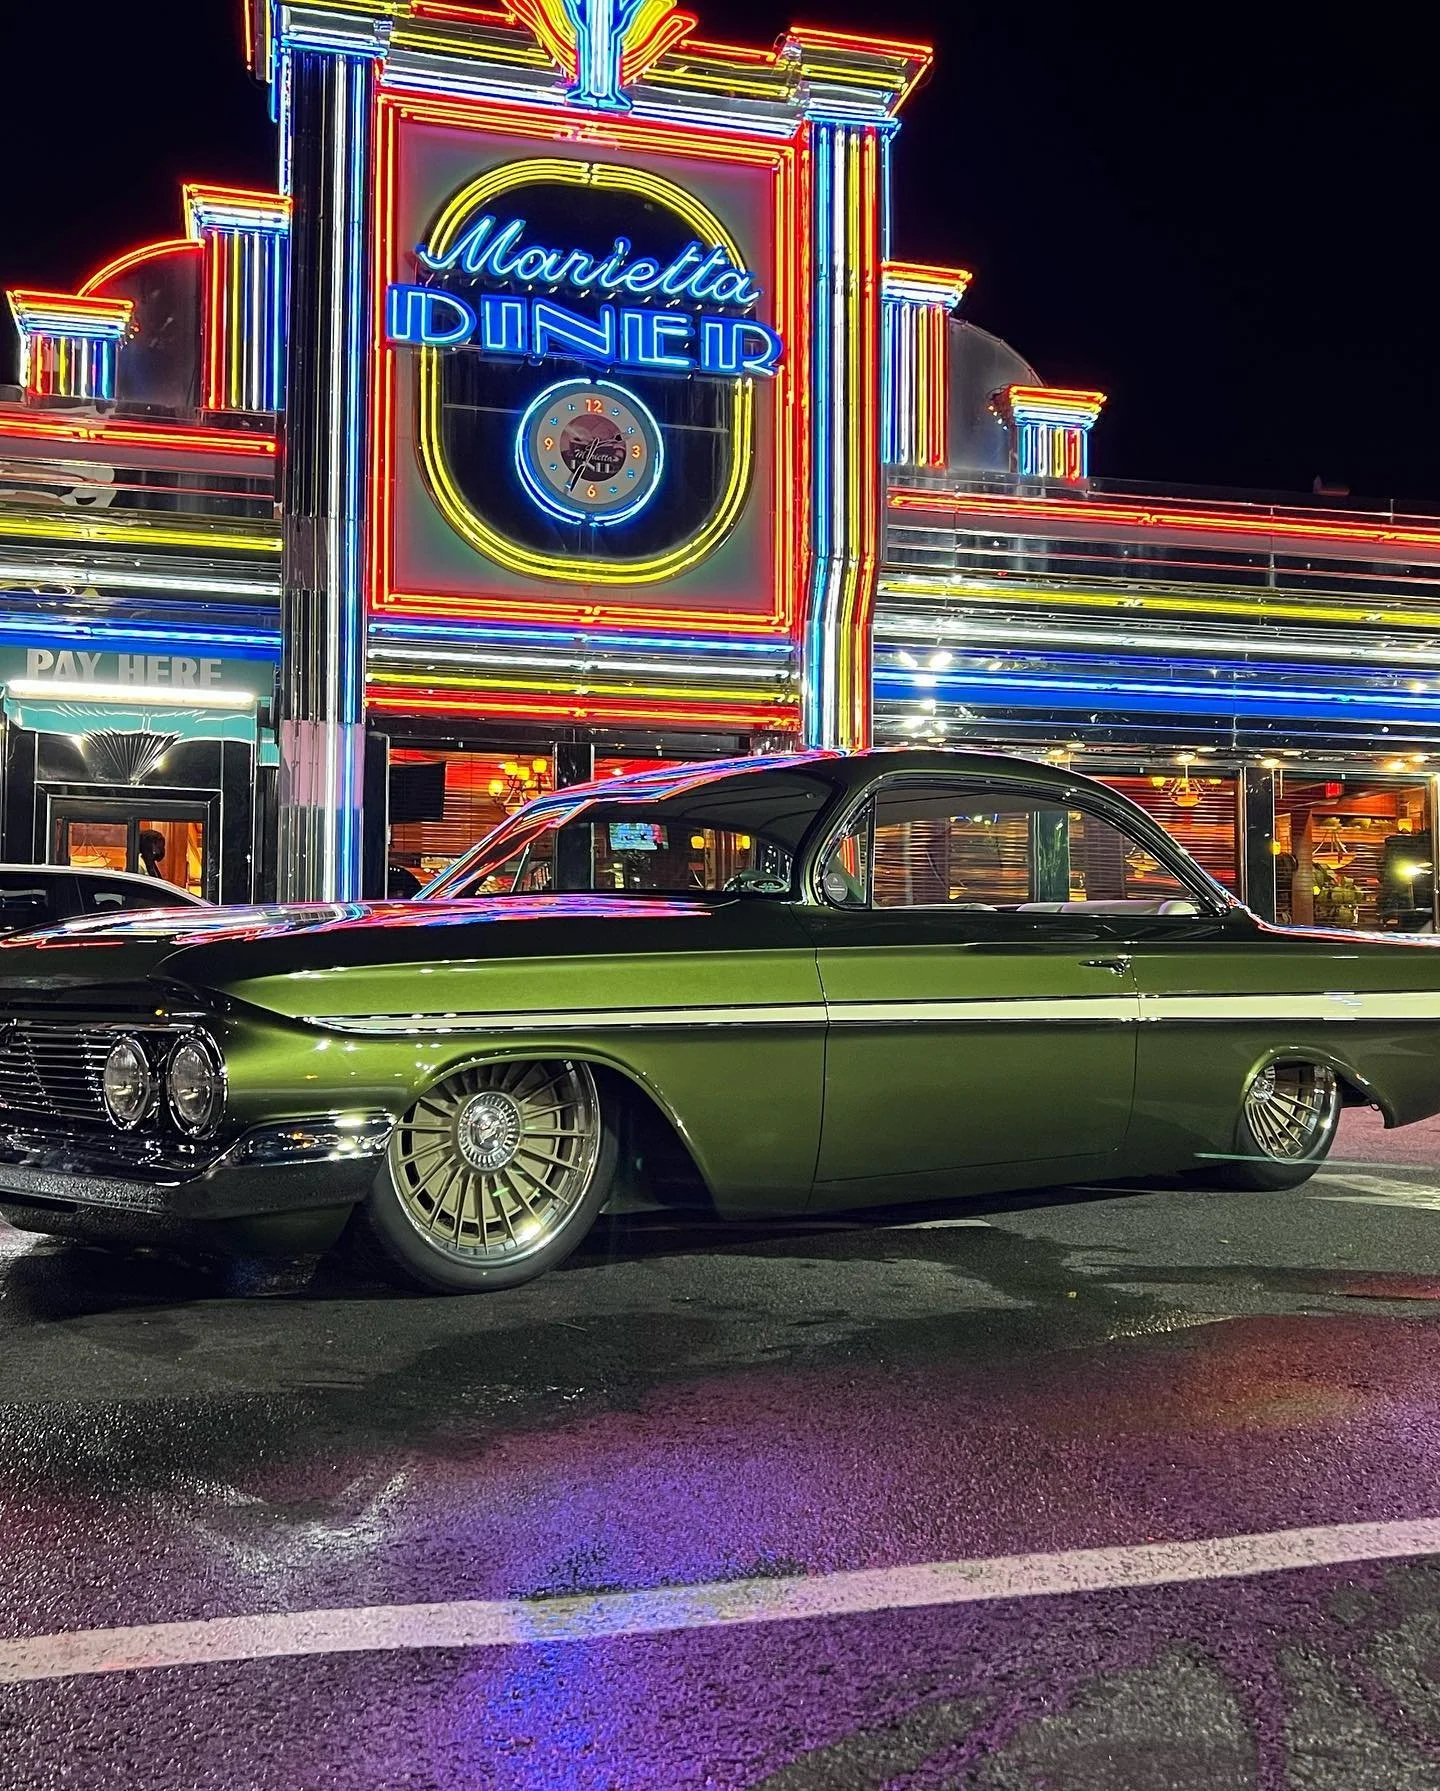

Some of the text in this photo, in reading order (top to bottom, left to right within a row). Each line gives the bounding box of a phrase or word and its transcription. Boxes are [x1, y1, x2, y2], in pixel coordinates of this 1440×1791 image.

[417, 215, 763, 304] Marietta
[387, 283, 784, 377] DINER
[585, 399, 602, 413] 12
[544, 437, 554, 450] 9
[631, 445, 641, 458] 3
[587, 484, 596, 498] 6
[26, 648, 222, 689] PAY HERE
